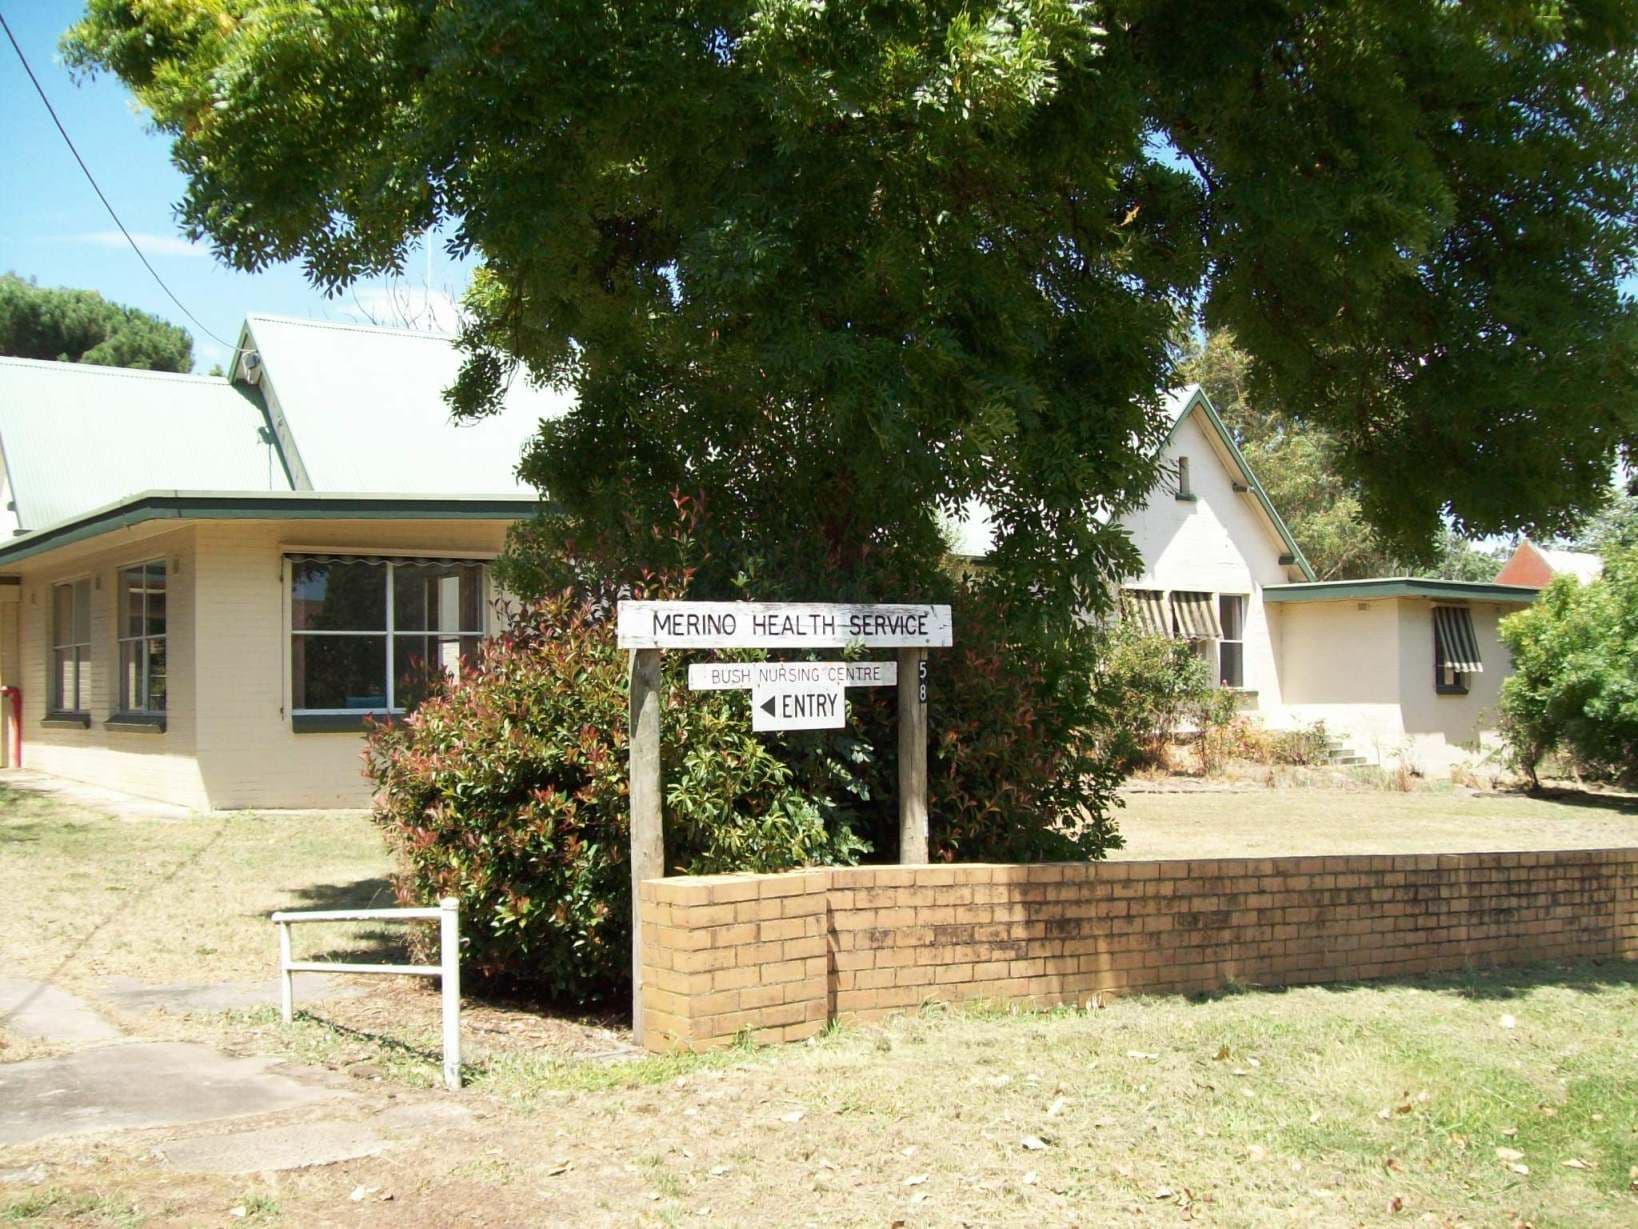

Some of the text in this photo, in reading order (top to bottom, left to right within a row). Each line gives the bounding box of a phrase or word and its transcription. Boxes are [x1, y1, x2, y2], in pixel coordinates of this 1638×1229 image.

[653, 613, 929, 636] MERINO HEALTH SERVICE
[712, 666, 881, 684] BUSH NURSING CENTRE
[782, 693, 838, 719] ENTRY
